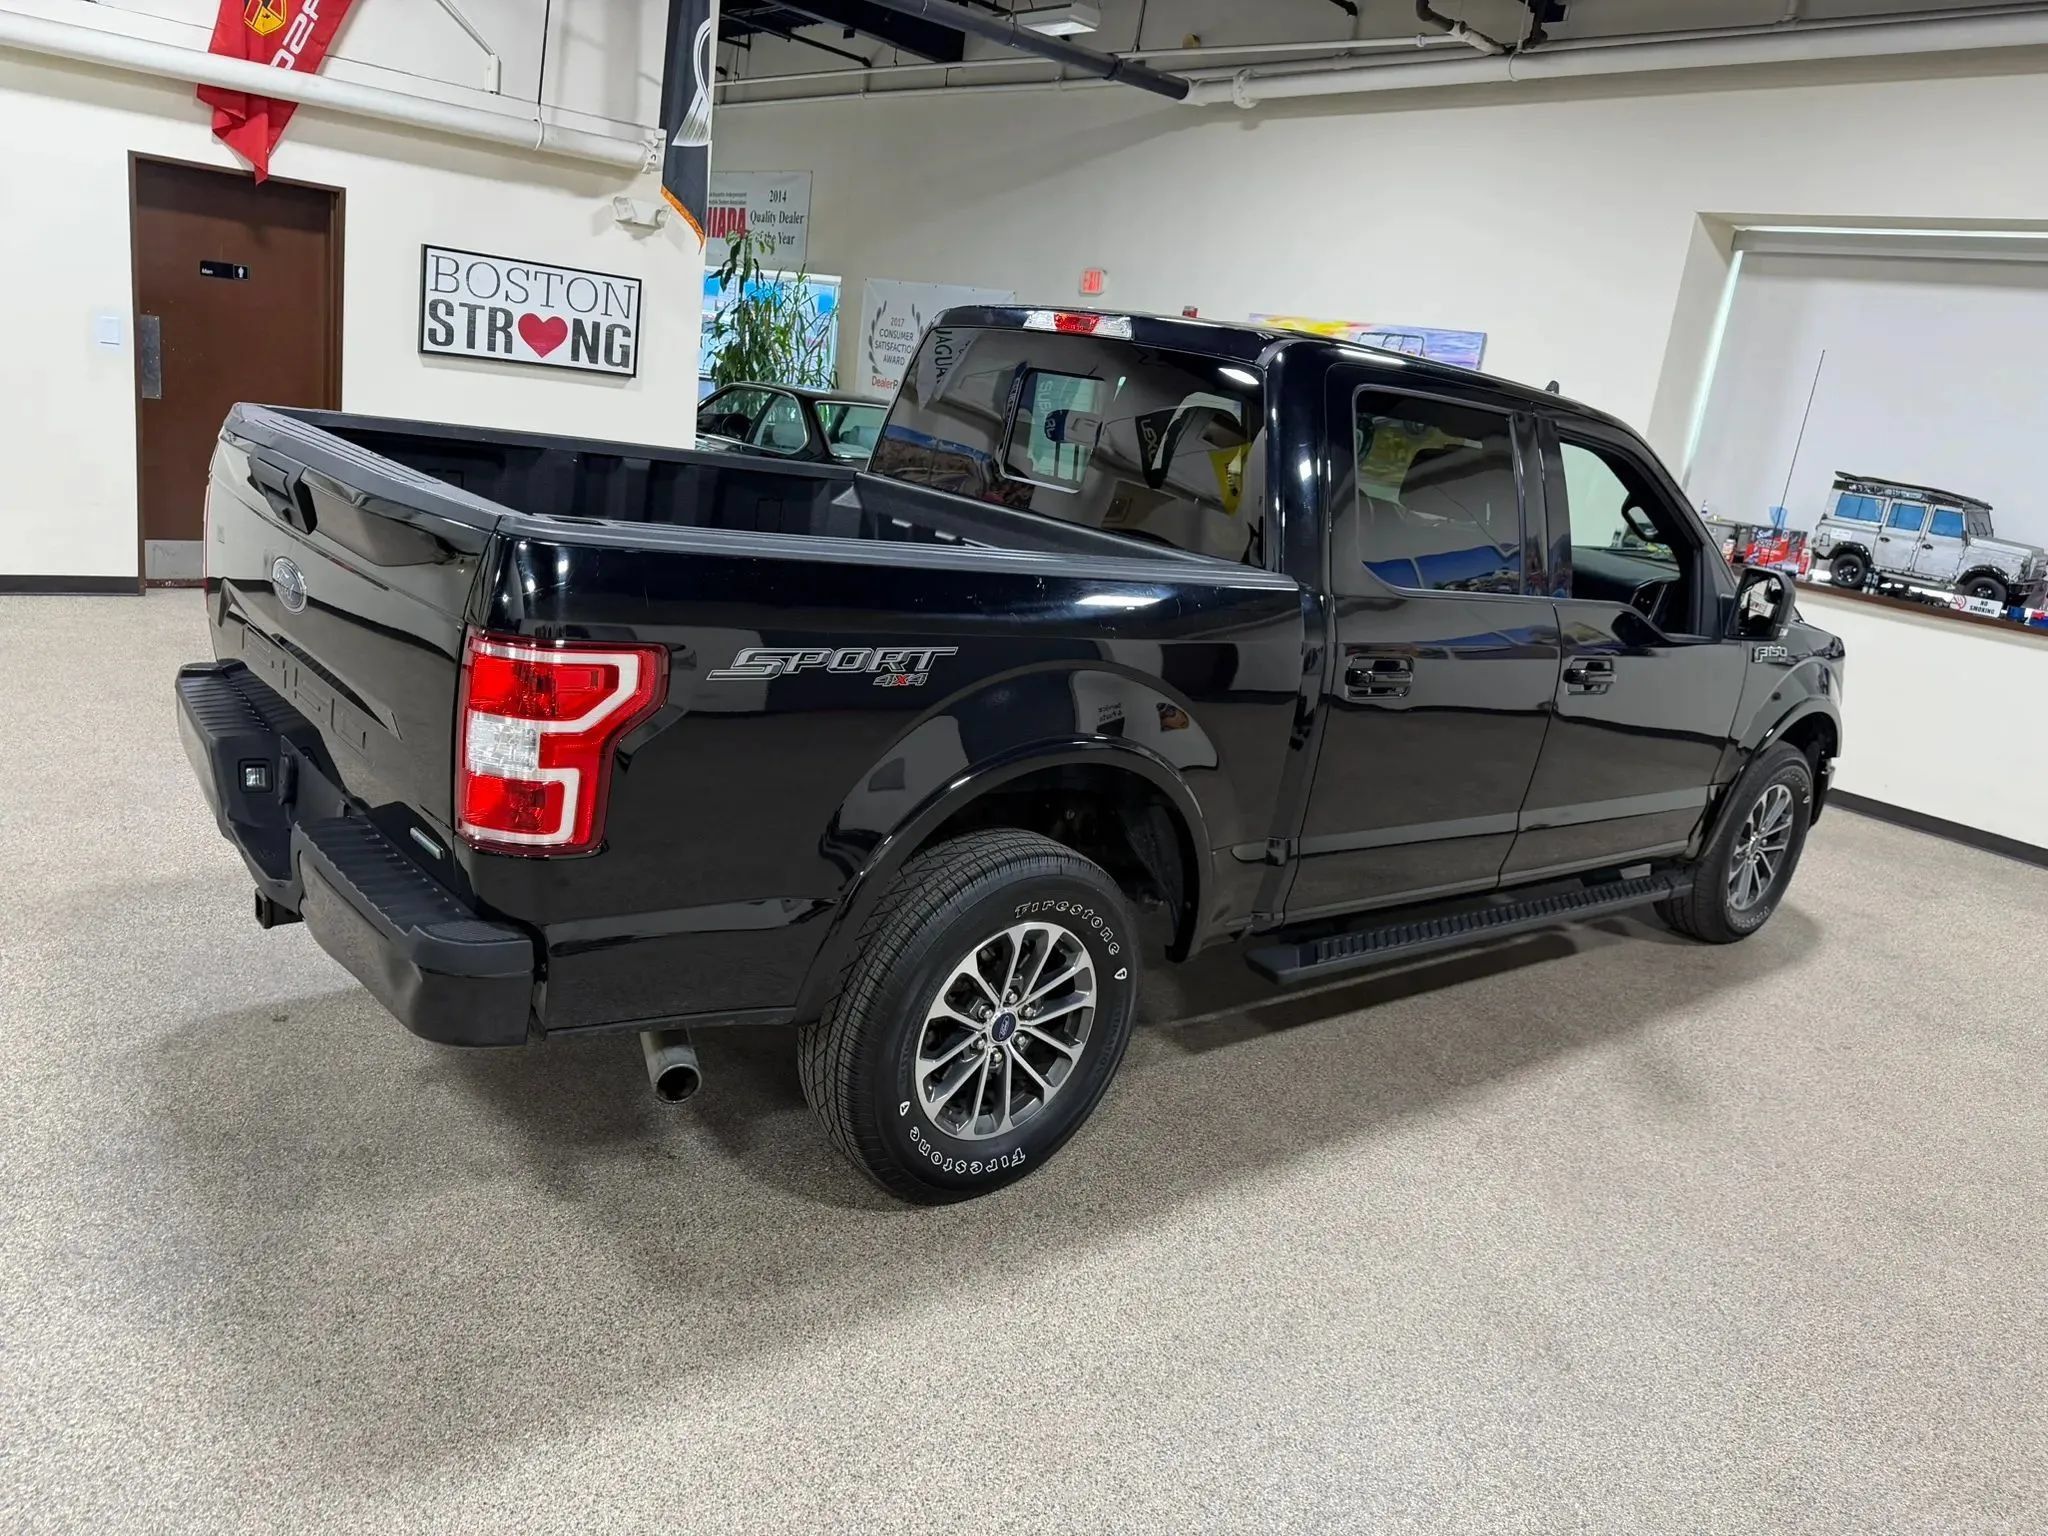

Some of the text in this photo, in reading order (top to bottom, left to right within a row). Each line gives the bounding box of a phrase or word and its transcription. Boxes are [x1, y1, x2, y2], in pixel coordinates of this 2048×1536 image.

[769, 190, 787, 203] 2014
[750, 210, 804, 227] Quality Dealer
[778, 232, 796, 245] Year
[430, 254, 635, 319] BOSTON
[890, 317, 905, 327] 2017
[879, 328, 913, 341] CONSUMER
[883, 354, 905, 366] AWARD
[935, 330, 952, 384] JAGUA
[1970, 605, 1995, 615] SMOKING
[706, 646, 958, 680] SPORT
[1014, 900, 1120, 955] Firestone
[909, 1127, 1026, 1174] Firestone
